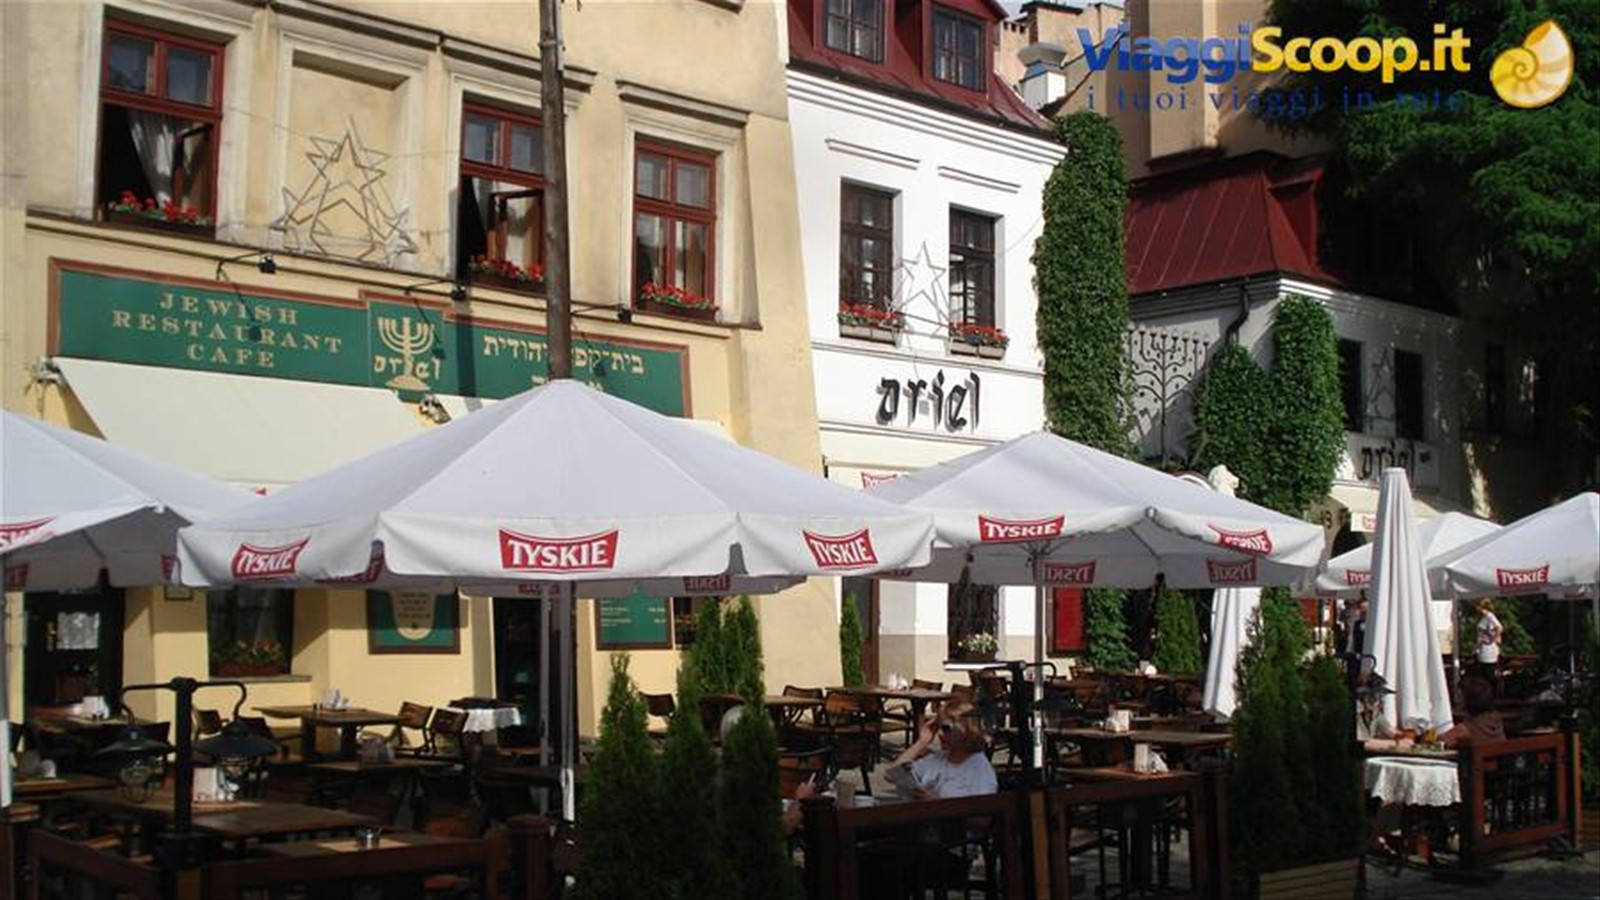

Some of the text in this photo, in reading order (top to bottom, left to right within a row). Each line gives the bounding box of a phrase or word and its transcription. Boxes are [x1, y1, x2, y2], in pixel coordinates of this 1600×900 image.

[159, 293, 298, 326] JEWISH
[112, 309, 343, 354] RESTAURANT
[186, 343, 276, 369] CAFE
[877, 368, 981, 433] ariel
[984, 520, 1058, 539] TYSKIE
[236, 550, 293, 573] TYSKIE
[507, 538, 610, 568] TYSKIE
[809, 536, 874, 564] TYSKIE
[1500, 567, 1548, 585] TYSKIE
